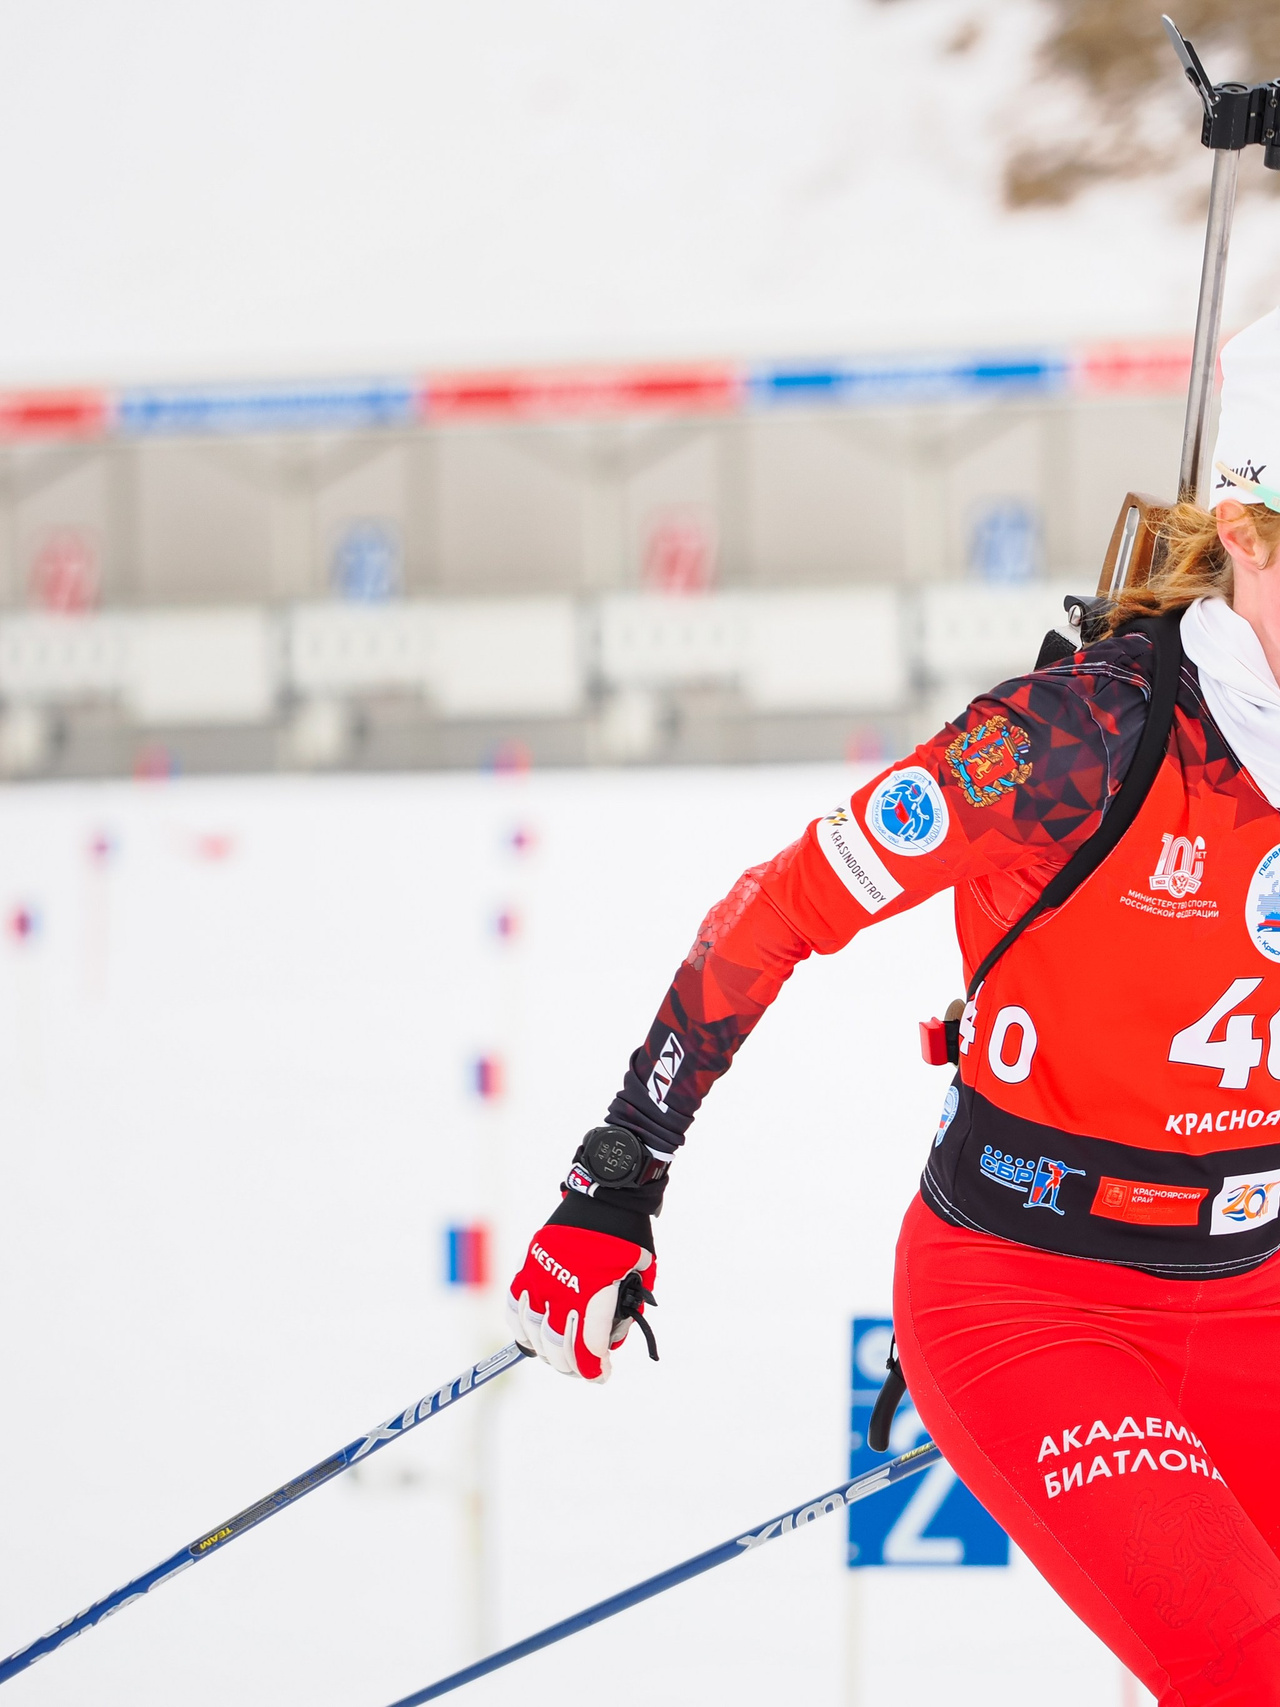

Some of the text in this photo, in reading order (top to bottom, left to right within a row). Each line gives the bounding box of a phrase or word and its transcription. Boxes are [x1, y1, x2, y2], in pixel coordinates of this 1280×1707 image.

[830, 829, 886, 903] KRASINDORSTROY
[1119, 896, 1219, 919] РОССИЙСКОЙ ФЕДЕРАЦИИ
[1127, 889, 1217, 910] МИНИСТЕРСТВО СПОРТА
[958, 980, 1039, 1085] 40
[603, 1140, 626, 1173] 15:51
[979, 1153, 1035, 1184] СБР
[1132, 1187, 1202, 1200] КРАСНОЯРСКИЙ
[531, 1243, 580, 1293] HESTRA
[1037, 1416, 1211, 1463] АКАДЕМИ
[881, 1402, 966, 1566] 2
[1044, 1448, 1229, 1500] БИАТЛОНА
[199, 1526, 233, 1550] TEAM
